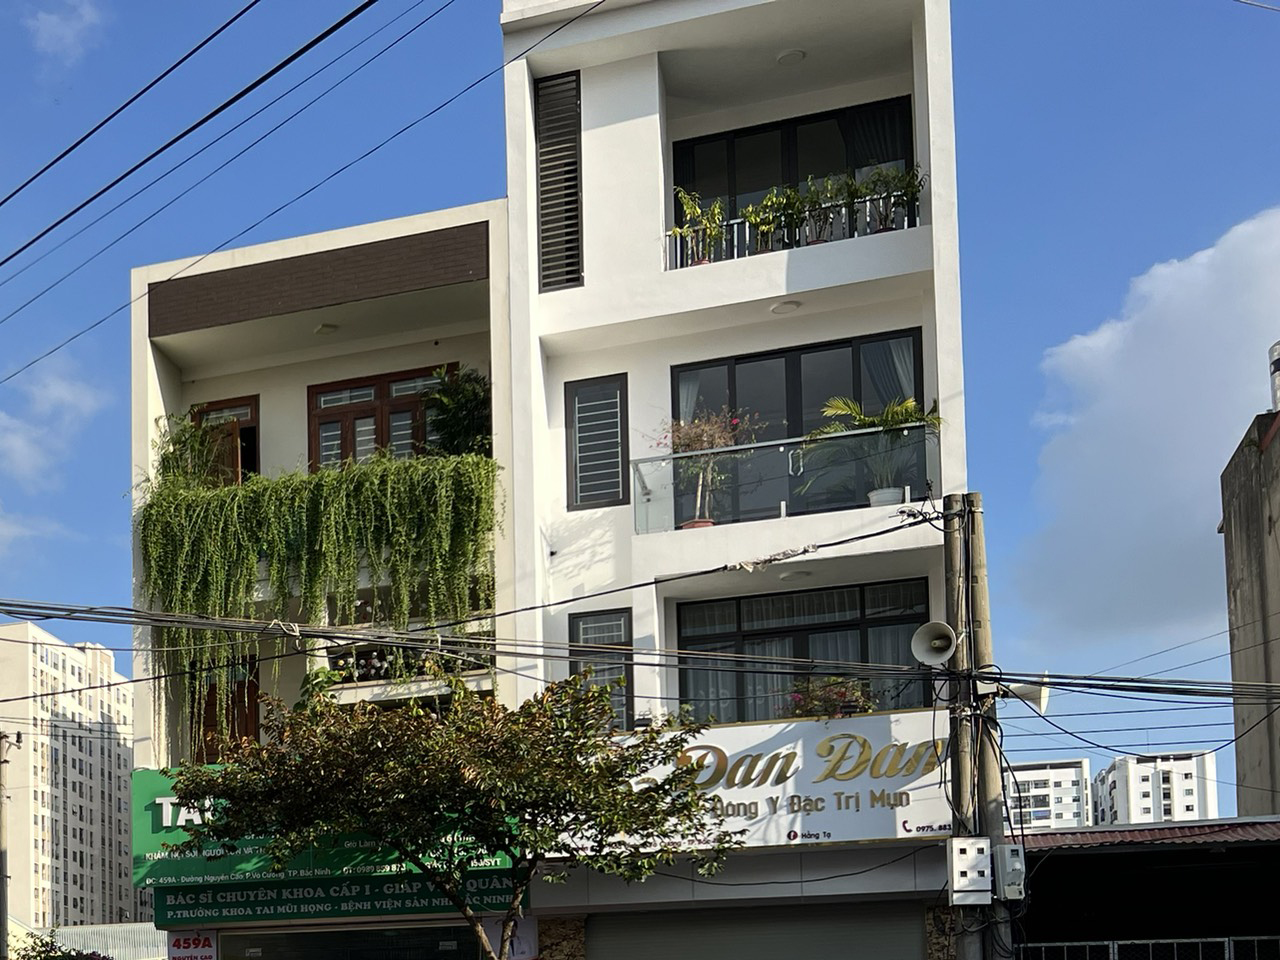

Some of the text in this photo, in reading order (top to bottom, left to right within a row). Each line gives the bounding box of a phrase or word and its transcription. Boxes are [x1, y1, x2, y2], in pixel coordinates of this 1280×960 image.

[811, 733, 950, 784] Đan
[766, 795, 780, 814] Y
[788, 794, 825, 816] Đặc
[833, 790, 860, 813] Trị
[869, 788, 910, 811] Mụn
[159, 875, 177, 884] 459A
[314, 867, 331, 876] Ninh
[466, 875, 514, 892] QUÂN
[166, 891, 195, 906] BÁC
[199, 890, 213, 903] SĨ
[216, 887, 278, 903] CHUYÊN
[281, 886, 325, 900] KHOA
[329, 881, 360, 897] CẤP
[364, 884, 371, 896] I
[383, 879, 422, 895] GIÁP
[222, 906, 253, 917] KHOA
[255, 905, 275, 915] TAI
[277, 902, 297, 914] MŨI
[300, 903, 332, 915] HỌNG
[340, 900, 371, 913] BỆNH
[374, 899, 402, 911] VIỆN
[483, 895, 513, 905] NINH
[172, 936, 213, 949] 459A
